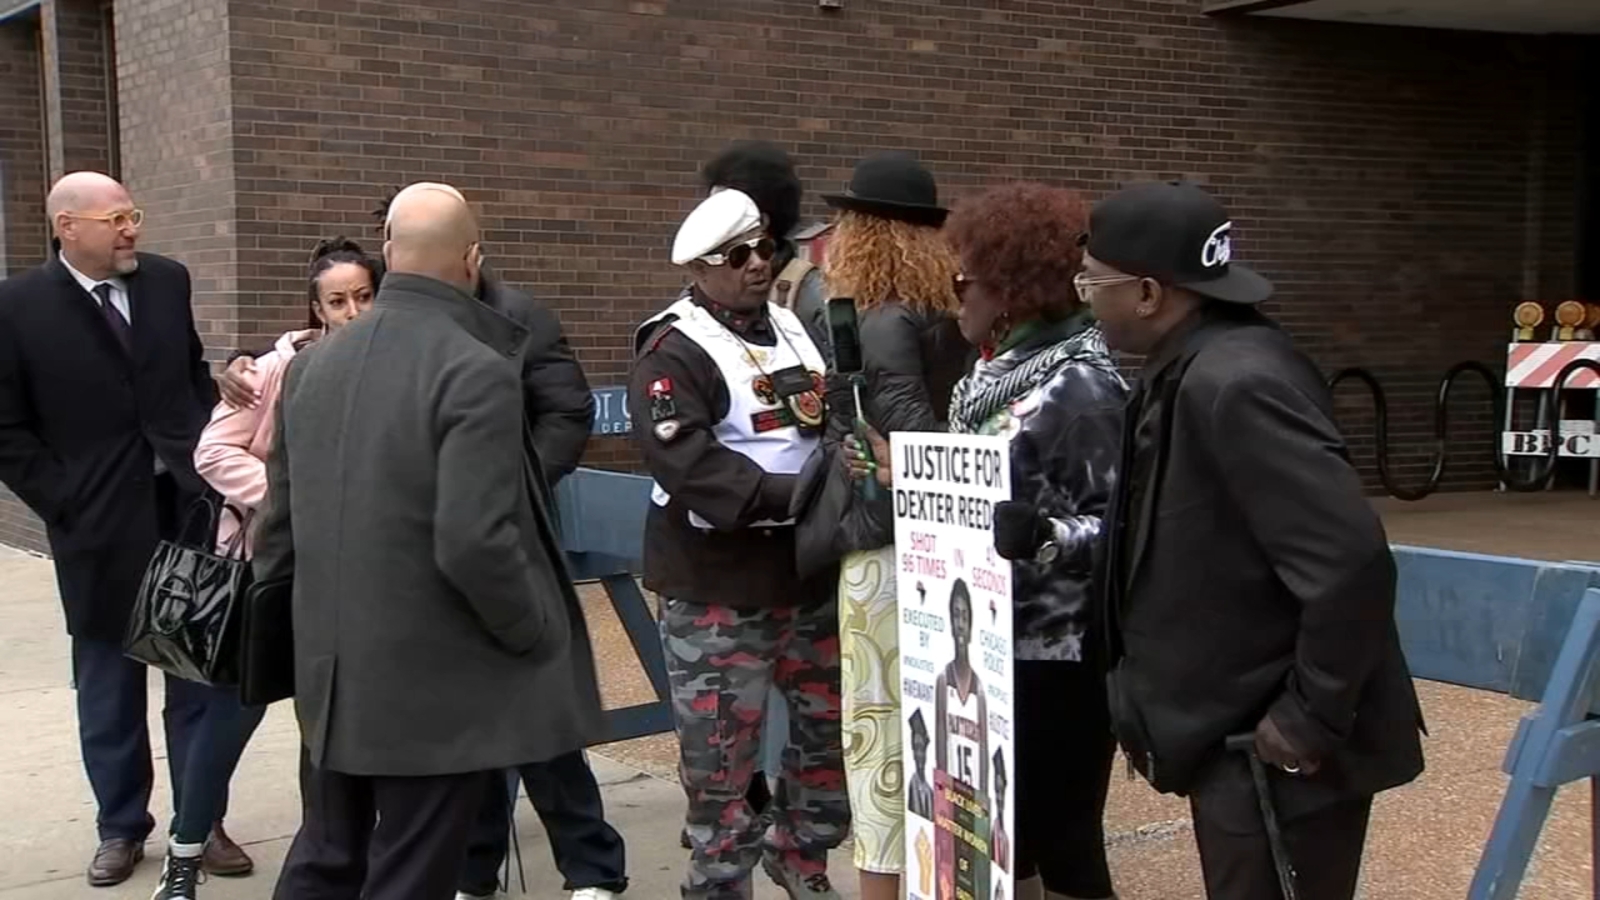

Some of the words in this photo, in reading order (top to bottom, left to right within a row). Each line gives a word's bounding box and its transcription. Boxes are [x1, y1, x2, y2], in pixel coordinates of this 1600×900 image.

[601, 421, 632, 434] DEP
[1512, 434, 1590, 455] BPC
[903, 444, 970, 484] JUSTICE
[974, 448, 1002, 489] FOR
[896, 489, 954, 525] DEXTER
[958, 495, 991, 531] REED
[910, 531, 937, 553] SHOT
[902, 553, 914, 573] 96
[916, 555, 947, 580] TIMES
[972, 566, 1007, 596] SECONDS
[903, 607, 945, 633] EXECUTED
[919, 631, 930, 650] BY
[957, 744, 973, 786] 15
